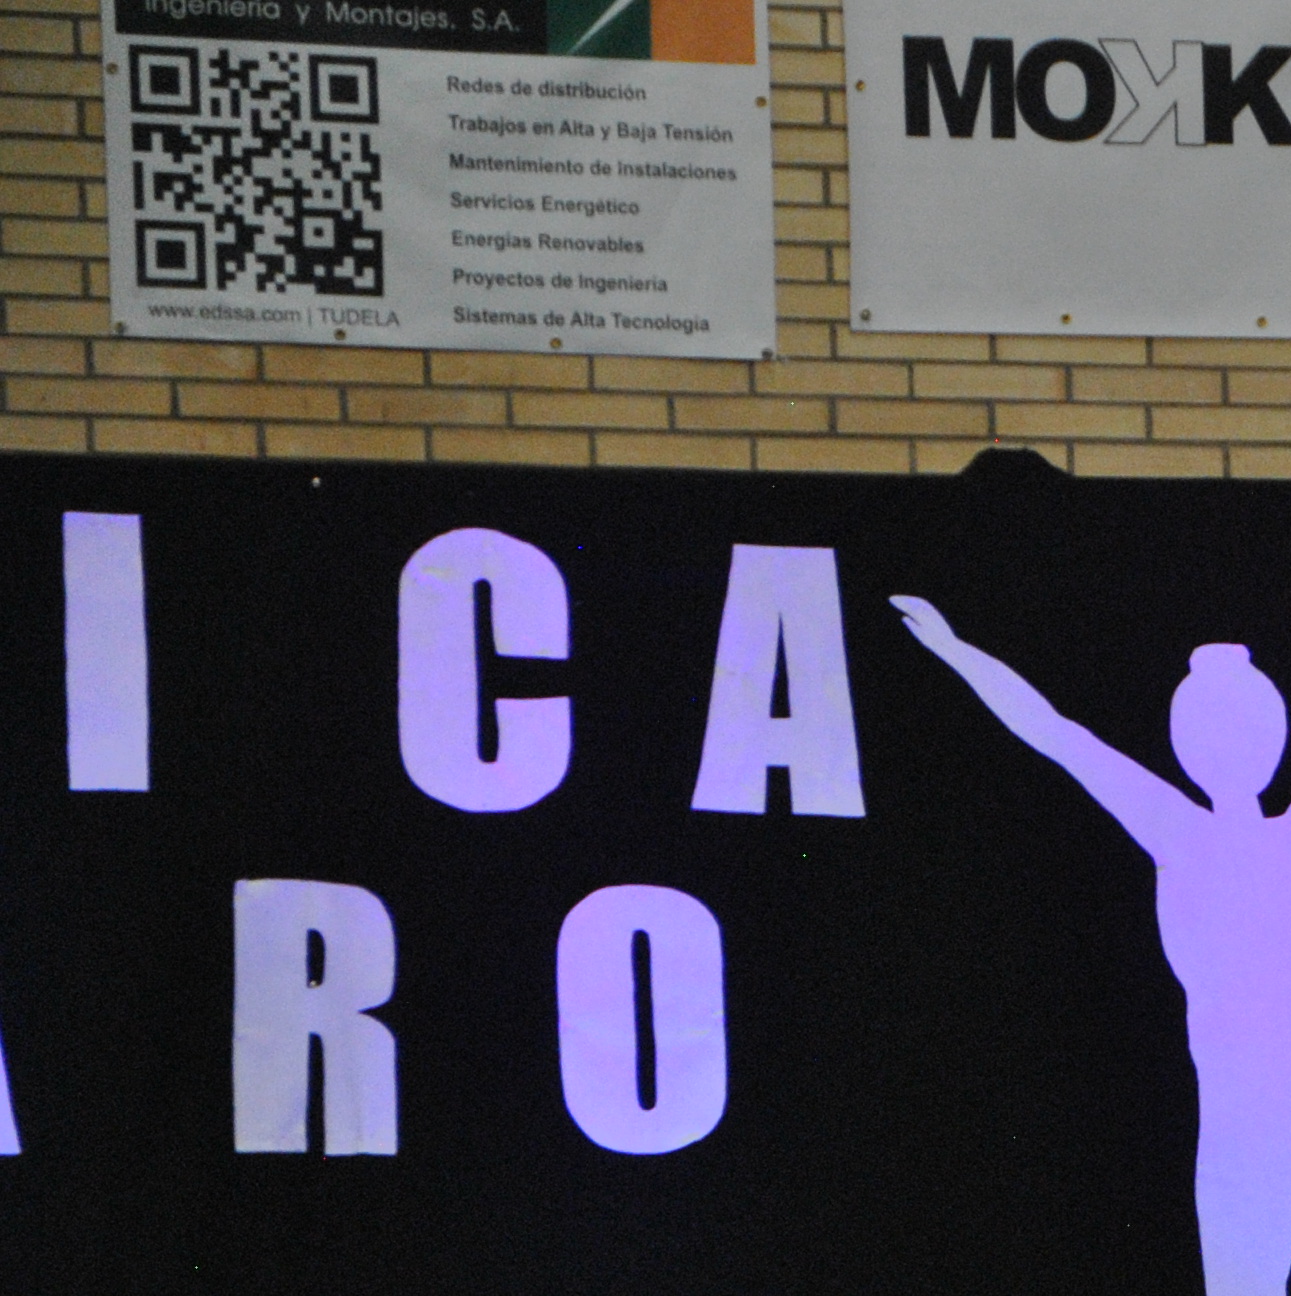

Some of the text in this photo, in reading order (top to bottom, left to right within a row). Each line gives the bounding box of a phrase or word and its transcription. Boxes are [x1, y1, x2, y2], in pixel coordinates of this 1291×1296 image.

[296, 3, 309, 25] y
[471, 14, 521, 32] S.A.
[447, 75, 648, 101] Redes de distribución
[449, 114, 734, 143] Trabajos en Alta y Baja Tensión
[449, 153, 583, 176] Mantenimiento
[589, 159, 612, 176] de
[450, 191, 641, 218] Servicios Energético
[538, 232, 644, 255] Renovables
[452, 267, 545, 291] Proyectos
[550, 273, 573, 290] de
[317, 307, 400, 327] TUDELA
[453, 305, 538, 326] Sistemas
[543, 310, 565, 328] de
[570, 311, 606, 330] Alta
